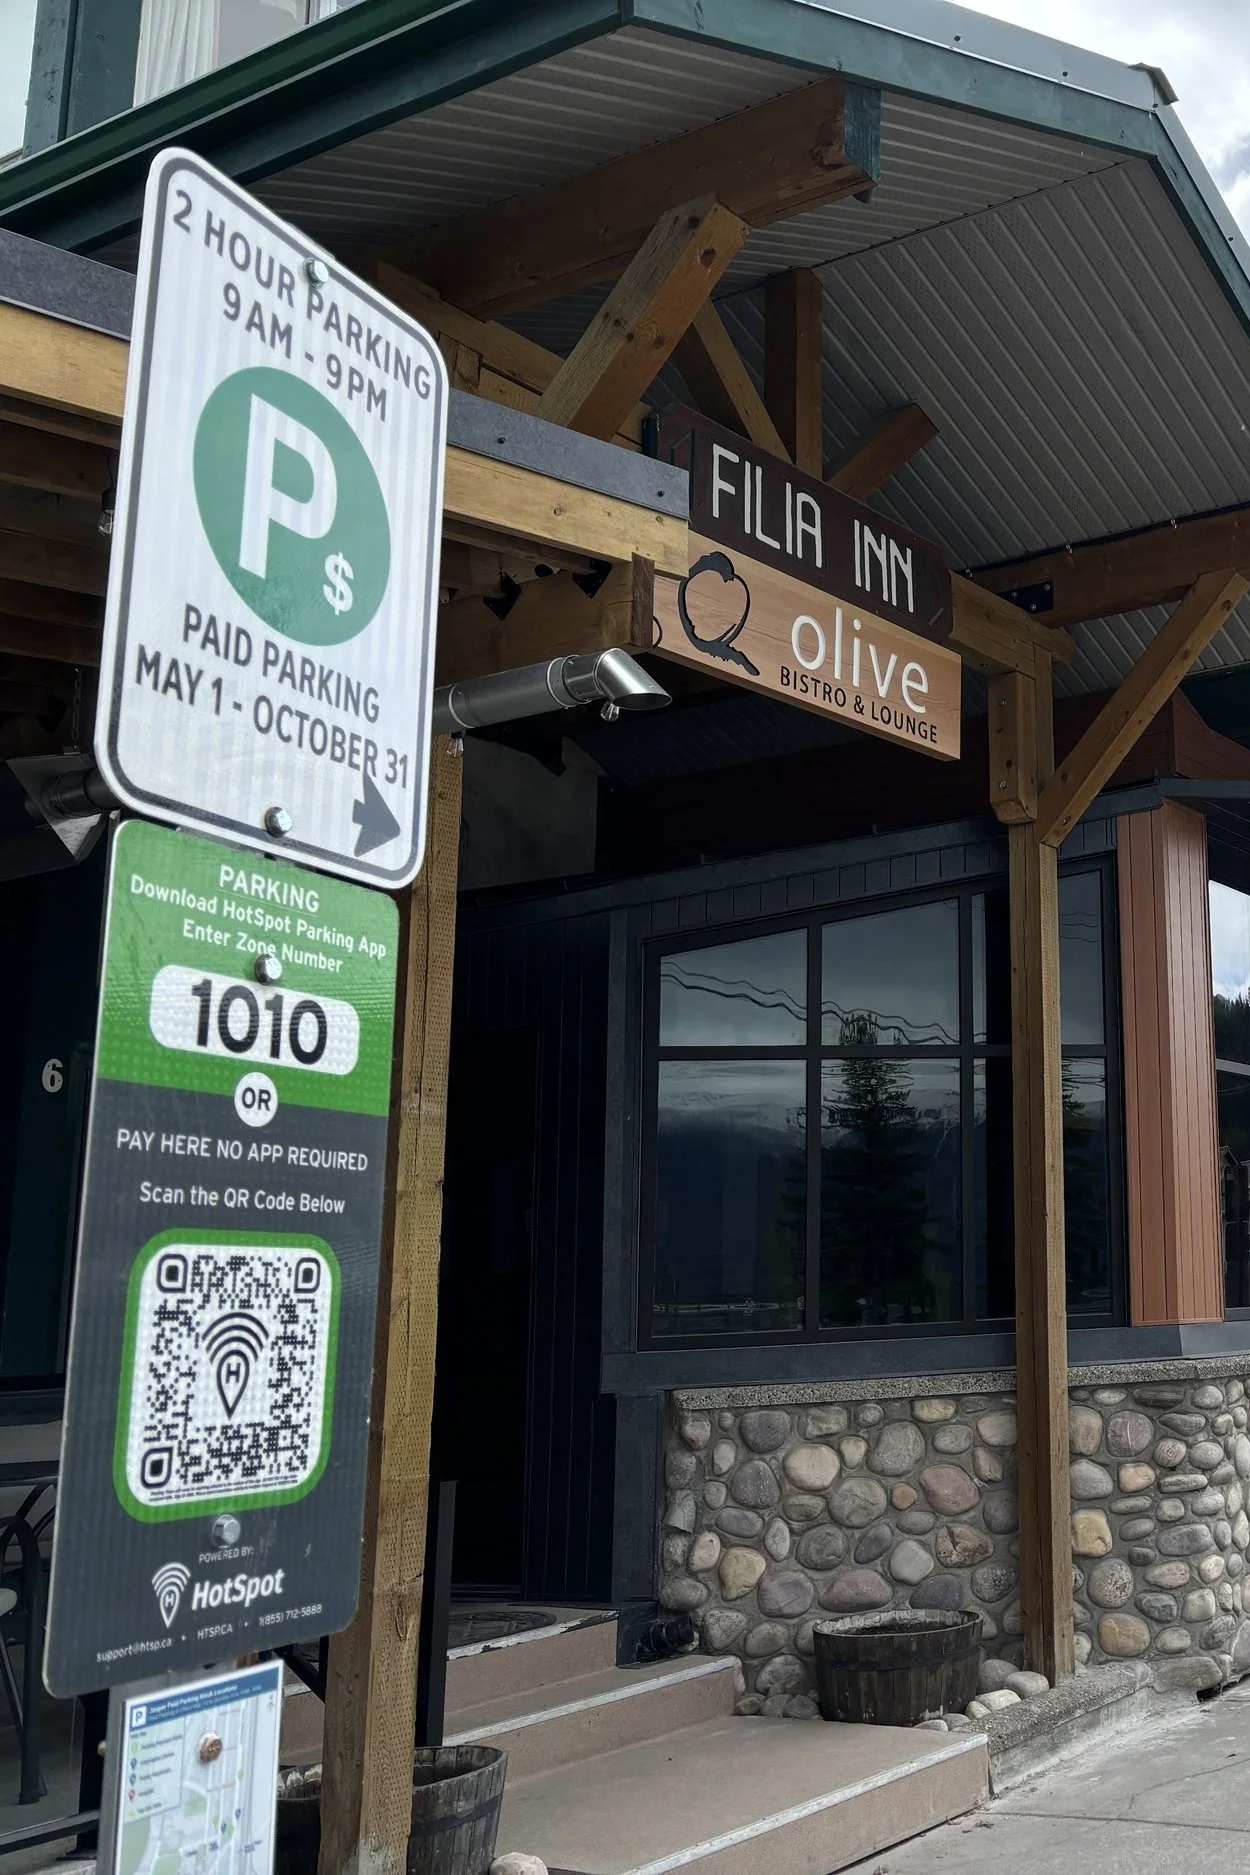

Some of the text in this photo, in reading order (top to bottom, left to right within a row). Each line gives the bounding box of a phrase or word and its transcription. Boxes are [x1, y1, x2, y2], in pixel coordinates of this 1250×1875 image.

[173, 189, 431, 400] 2 HOUR PARKING
[223, 282, 293, 360] 9AM
[326, 353, 387, 422] 9PM
[239, 393, 337, 579] P
[712, 443, 914, 613] FILIA INN
[182, 603, 380, 724] PAID PARKING
[791, 606, 929, 714] olive
[135, 643, 204, 706] MAY
[211, 676, 223, 716] 1
[253, 695, 378, 777] OCTOBER
[385, 748, 408, 789] 31
[780, 665, 938, 744] BISTRO & LOUNGE
[130, 874, 387, 959] Download HotSpot Parking App
[219, 864, 320, 913] PARKING
[183, 918, 344, 973] Enter Zone Number
[191, 978, 328, 1065] 1010
[42, 1058, 63, 1093] 6
[242, 1087, 272, 1111] OR
[116, 1128, 369, 1171] PAY HERE NO APP REQUIRED
[140, 1182, 345, 1214] Scan the QR Code Below
[191, 1568, 285, 1611] HotSpot
[198, 1546, 254, 1564] POWERED BY:
[96, 1637, 172, 1663] support@htsp.ca
[285, 1603, 323, 1621] 712-5888
